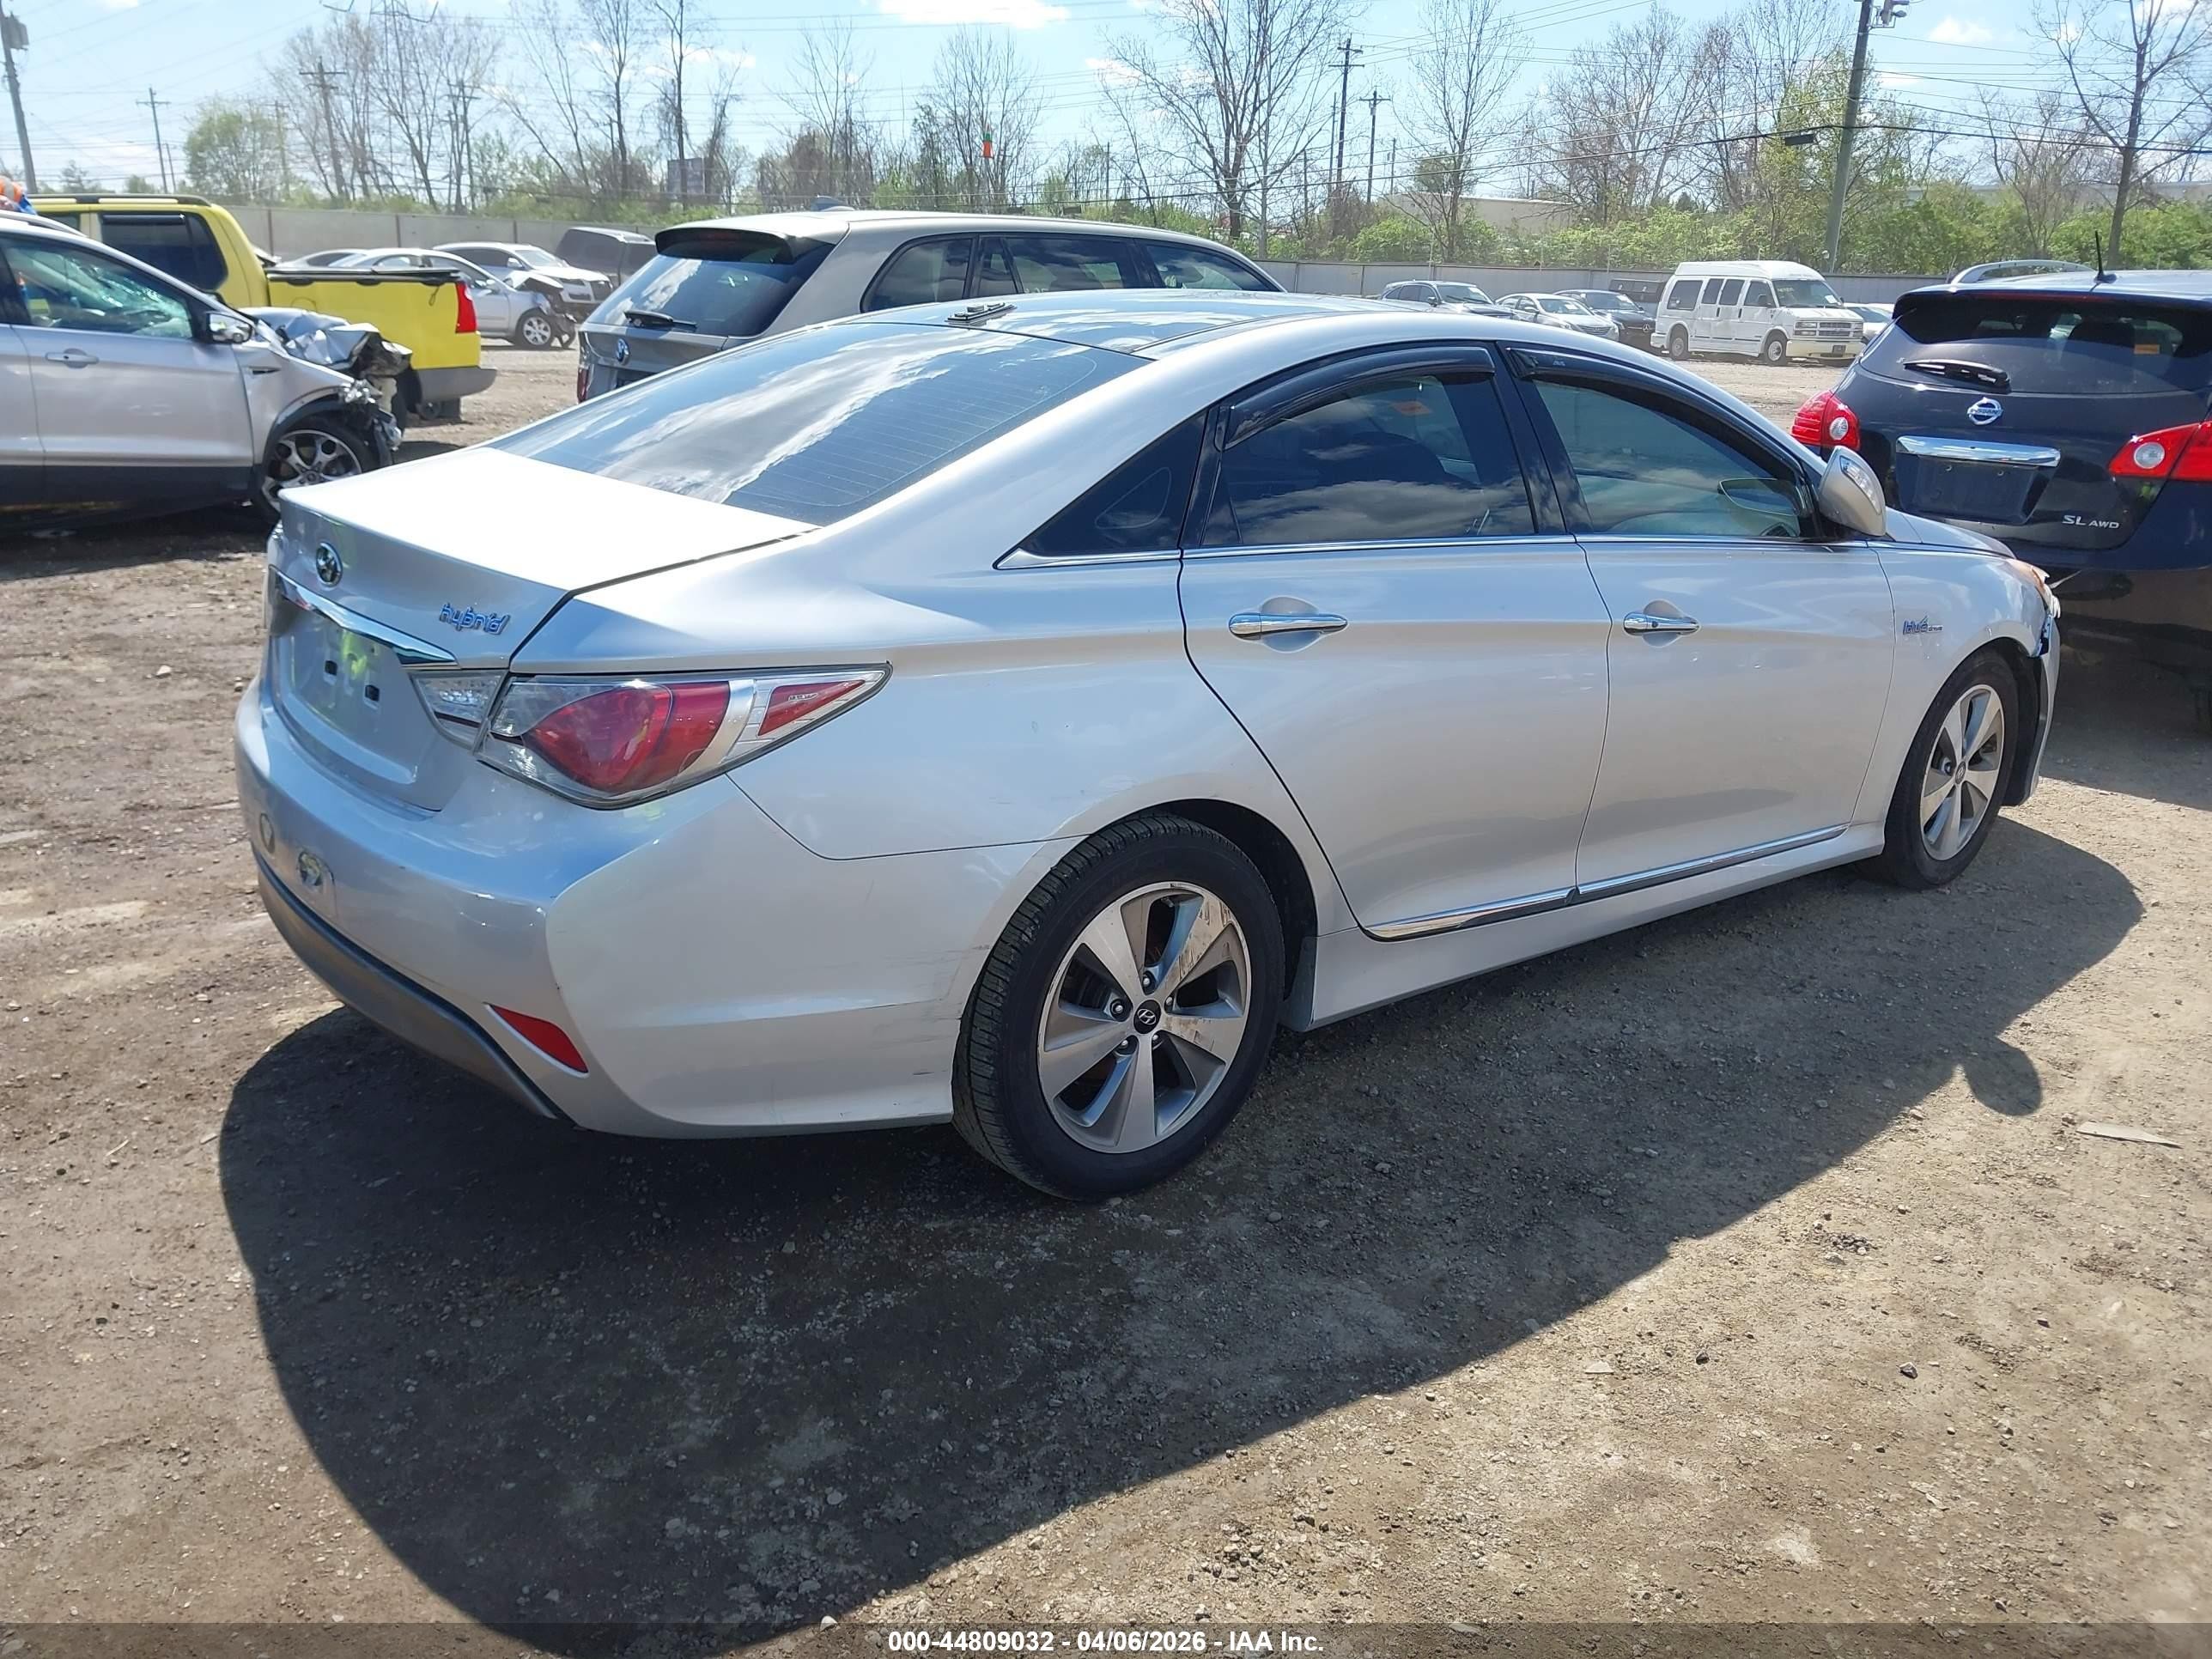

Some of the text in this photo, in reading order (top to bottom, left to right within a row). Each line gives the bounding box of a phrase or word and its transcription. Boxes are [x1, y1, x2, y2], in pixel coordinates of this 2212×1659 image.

[2062, 515, 2120, 529] SL AWD
[439, 602, 511, 635] hybrid
